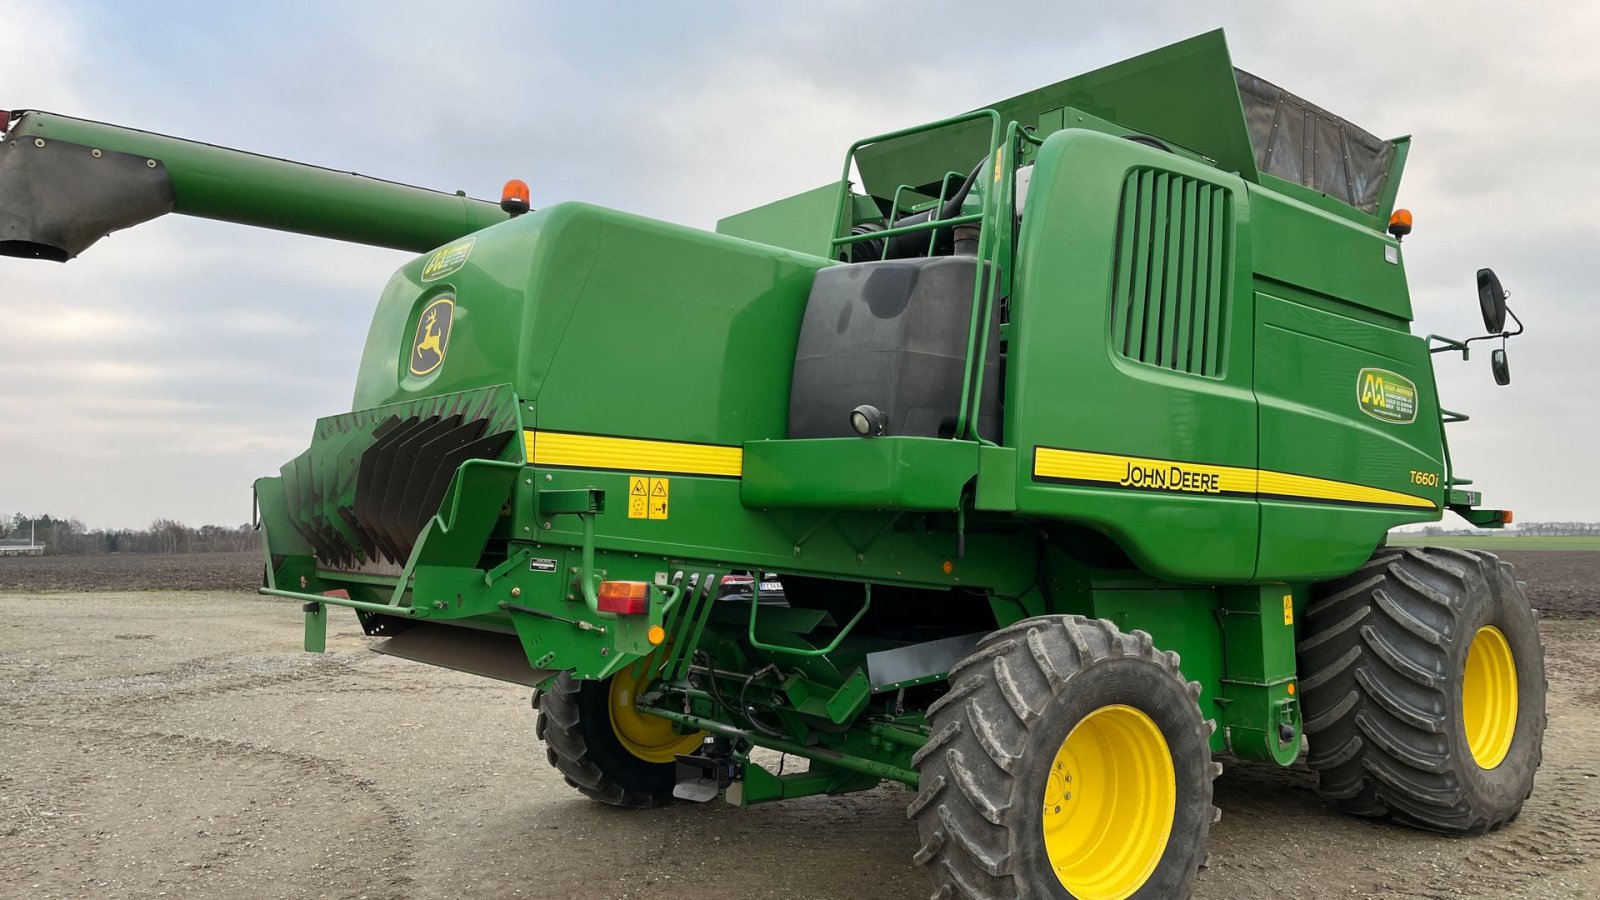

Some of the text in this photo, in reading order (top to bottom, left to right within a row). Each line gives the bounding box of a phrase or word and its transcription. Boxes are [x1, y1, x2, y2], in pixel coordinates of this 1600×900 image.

[1120, 461, 1220, 490] JOHN DEERE
[1410, 470, 1440, 488] T660i
